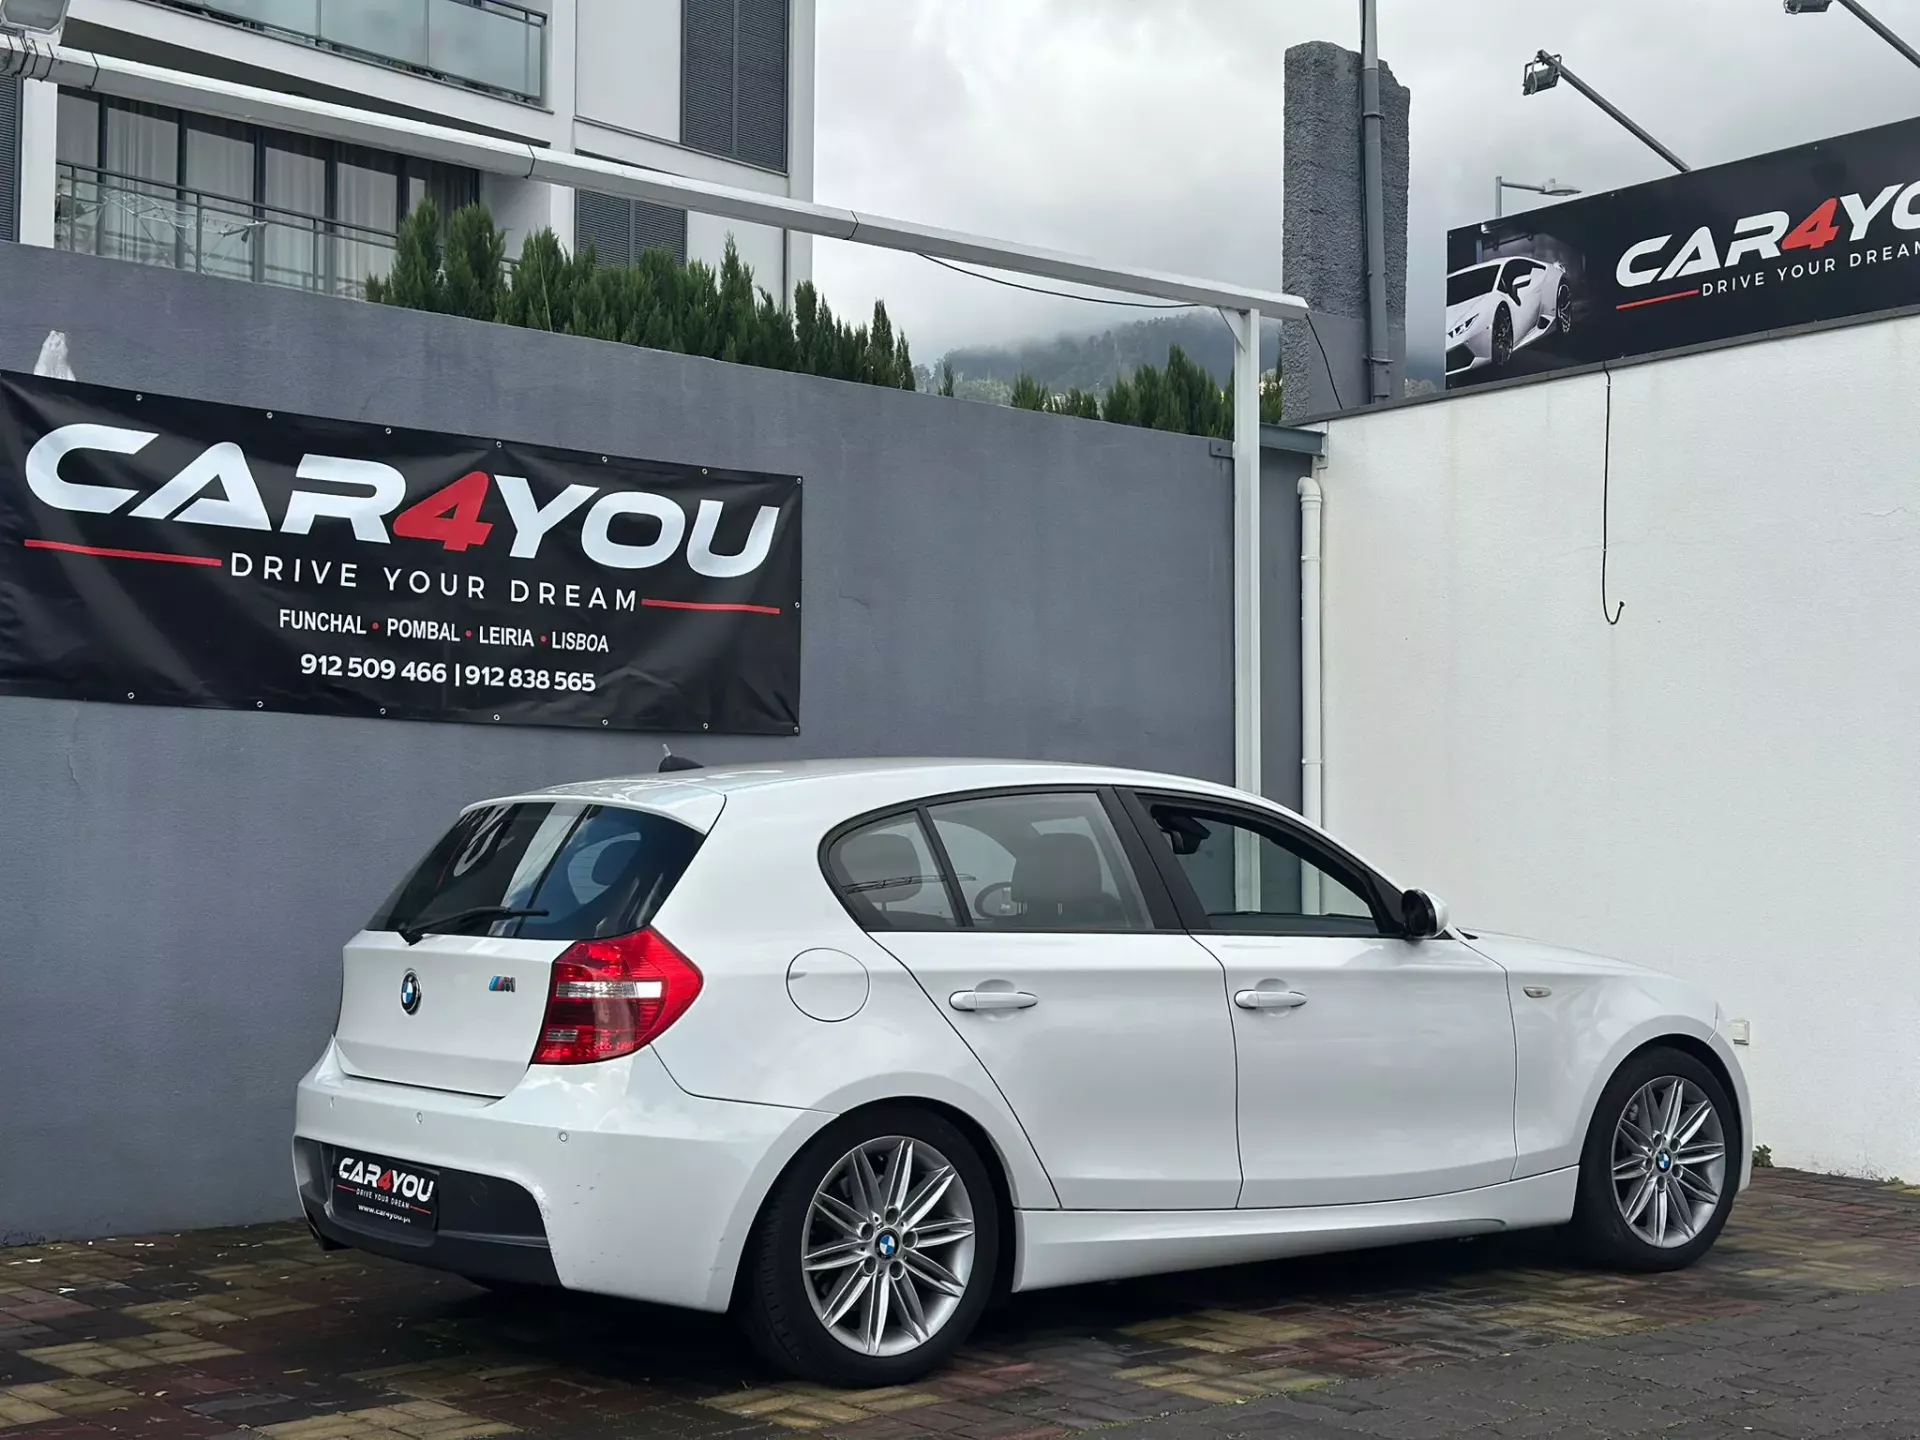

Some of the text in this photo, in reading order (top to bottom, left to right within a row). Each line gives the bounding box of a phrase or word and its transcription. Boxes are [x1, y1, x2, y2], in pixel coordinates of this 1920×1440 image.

[1702, 271, 1766, 297] DRIVE
[1777, 258, 1836, 281] YOUR
[25, 422, 781, 578] CAR4YOU
[231, 552, 637, 612] DRIVE YOUR DREAM
[279, 609, 610, 653] FUNCHAL POMBAL LEIRIA LISBOA
[300, 653, 343, 677] 912
[347, 656, 396, 680] 509
[400, 661, 448, 684] 466
[464, 665, 505, 687] 912
[508, 668, 551, 690] 838
[553, 672, 597, 692] 565
[338, 1157, 435, 1203] CAR4YOU
[356, 1188, 410, 1210] DRIVE YOUR DREAM
